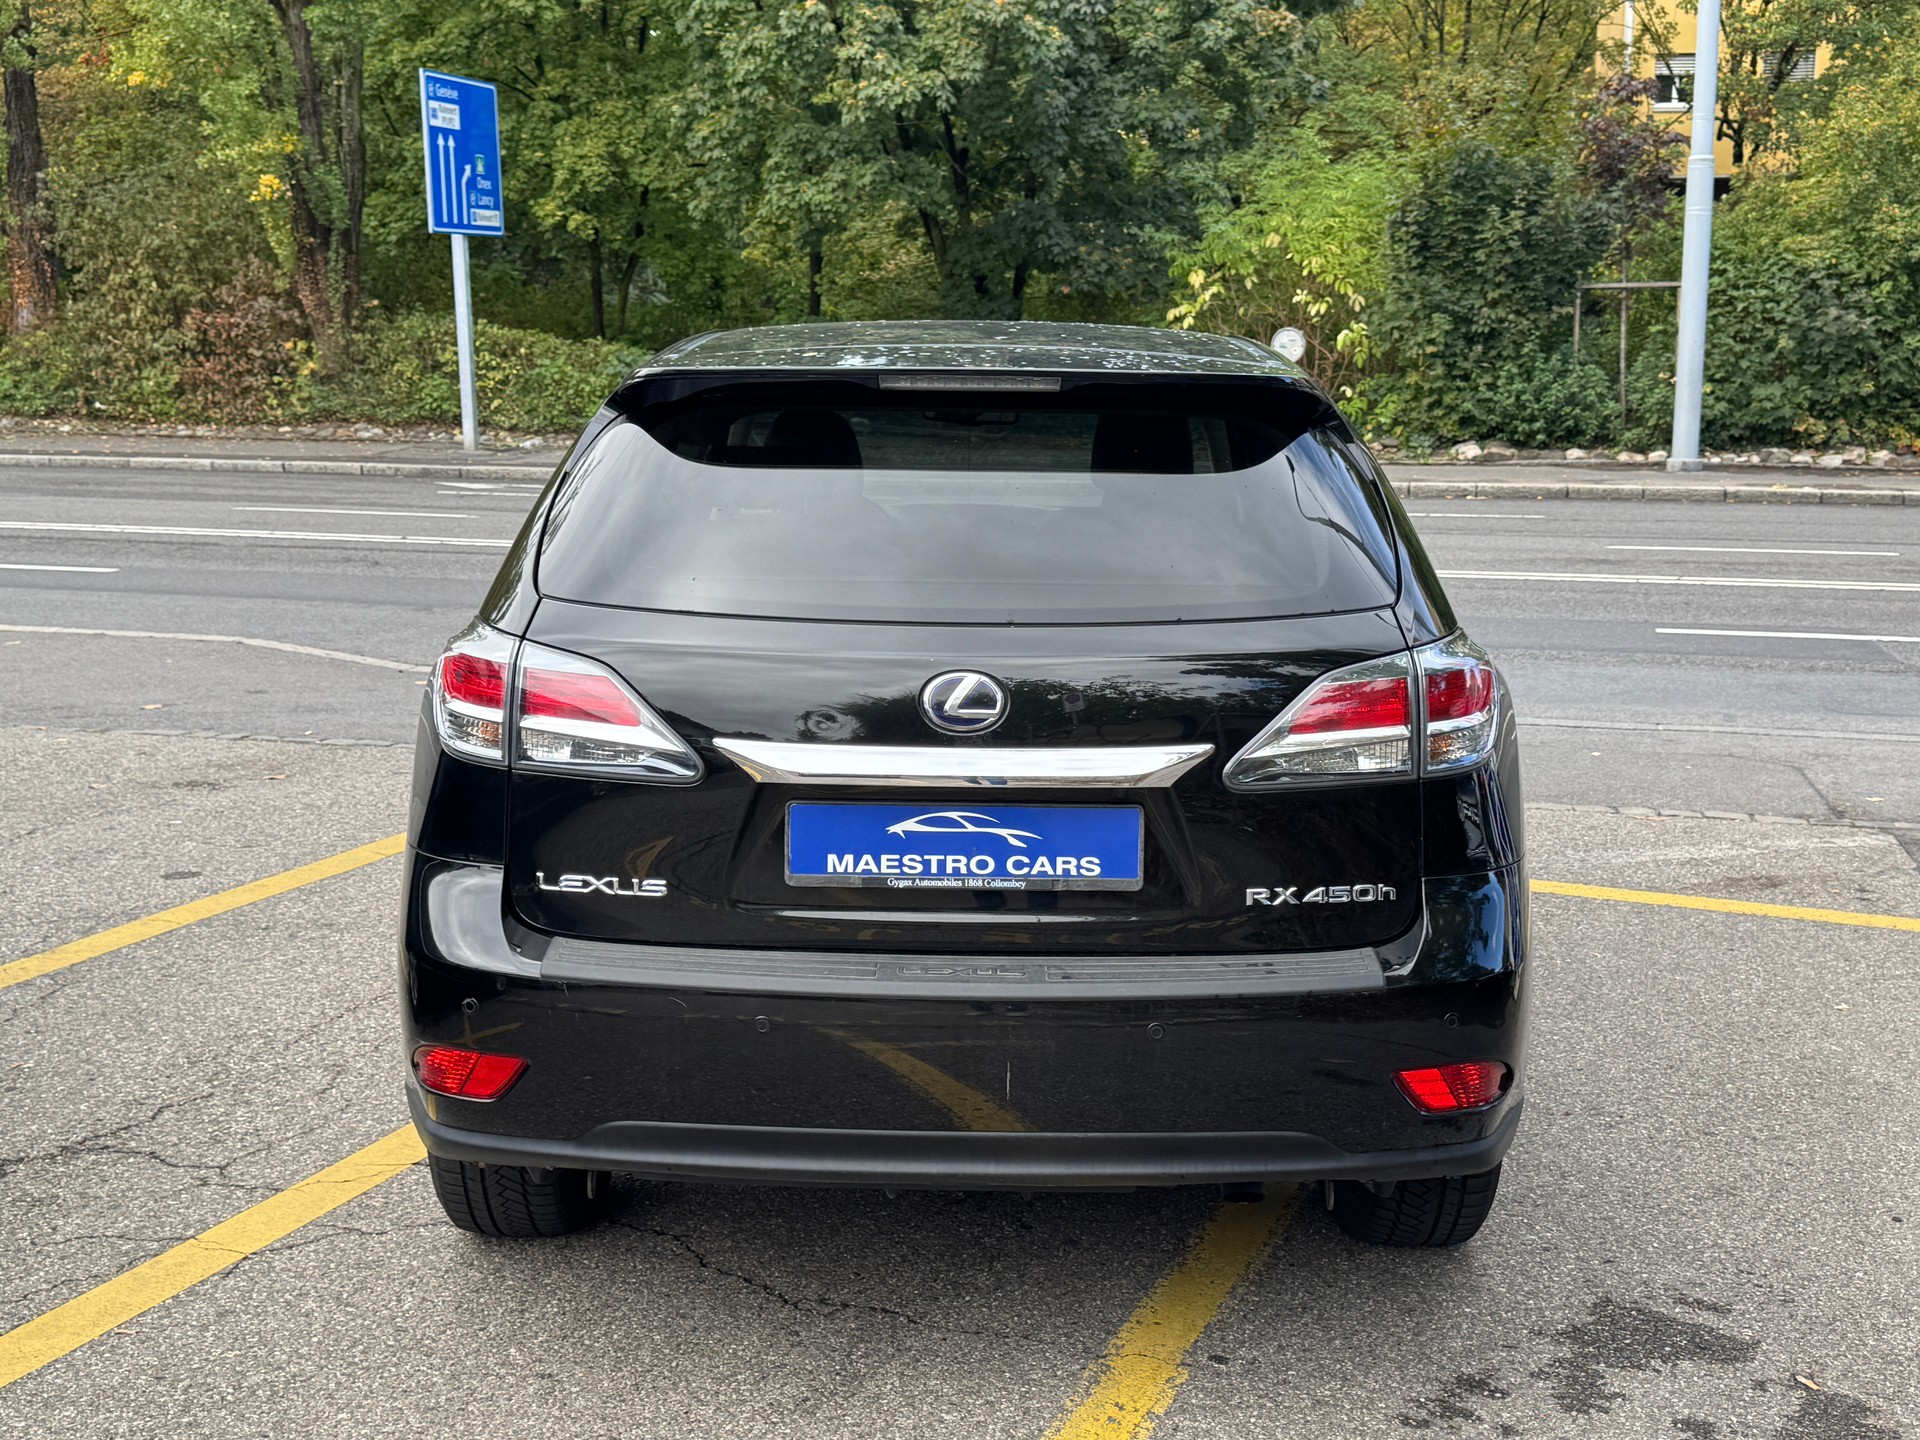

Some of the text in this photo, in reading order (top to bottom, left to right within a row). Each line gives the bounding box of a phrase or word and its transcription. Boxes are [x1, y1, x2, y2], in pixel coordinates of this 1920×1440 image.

[435, 83, 459, 100] Genève
[477, 176, 492, 190] Onex
[478, 192, 494, 209] Lancy
[826, 853, 1101, 877] MAESTRO CARS
[535, 871, 668, 897] LEXUS
[887, 877, 1027, 890] Gygax Automobiles 1868 Collombey
[1246, 883, 1396, 906] RX 450h
[896, 966, 1027, 979] LEXUS
